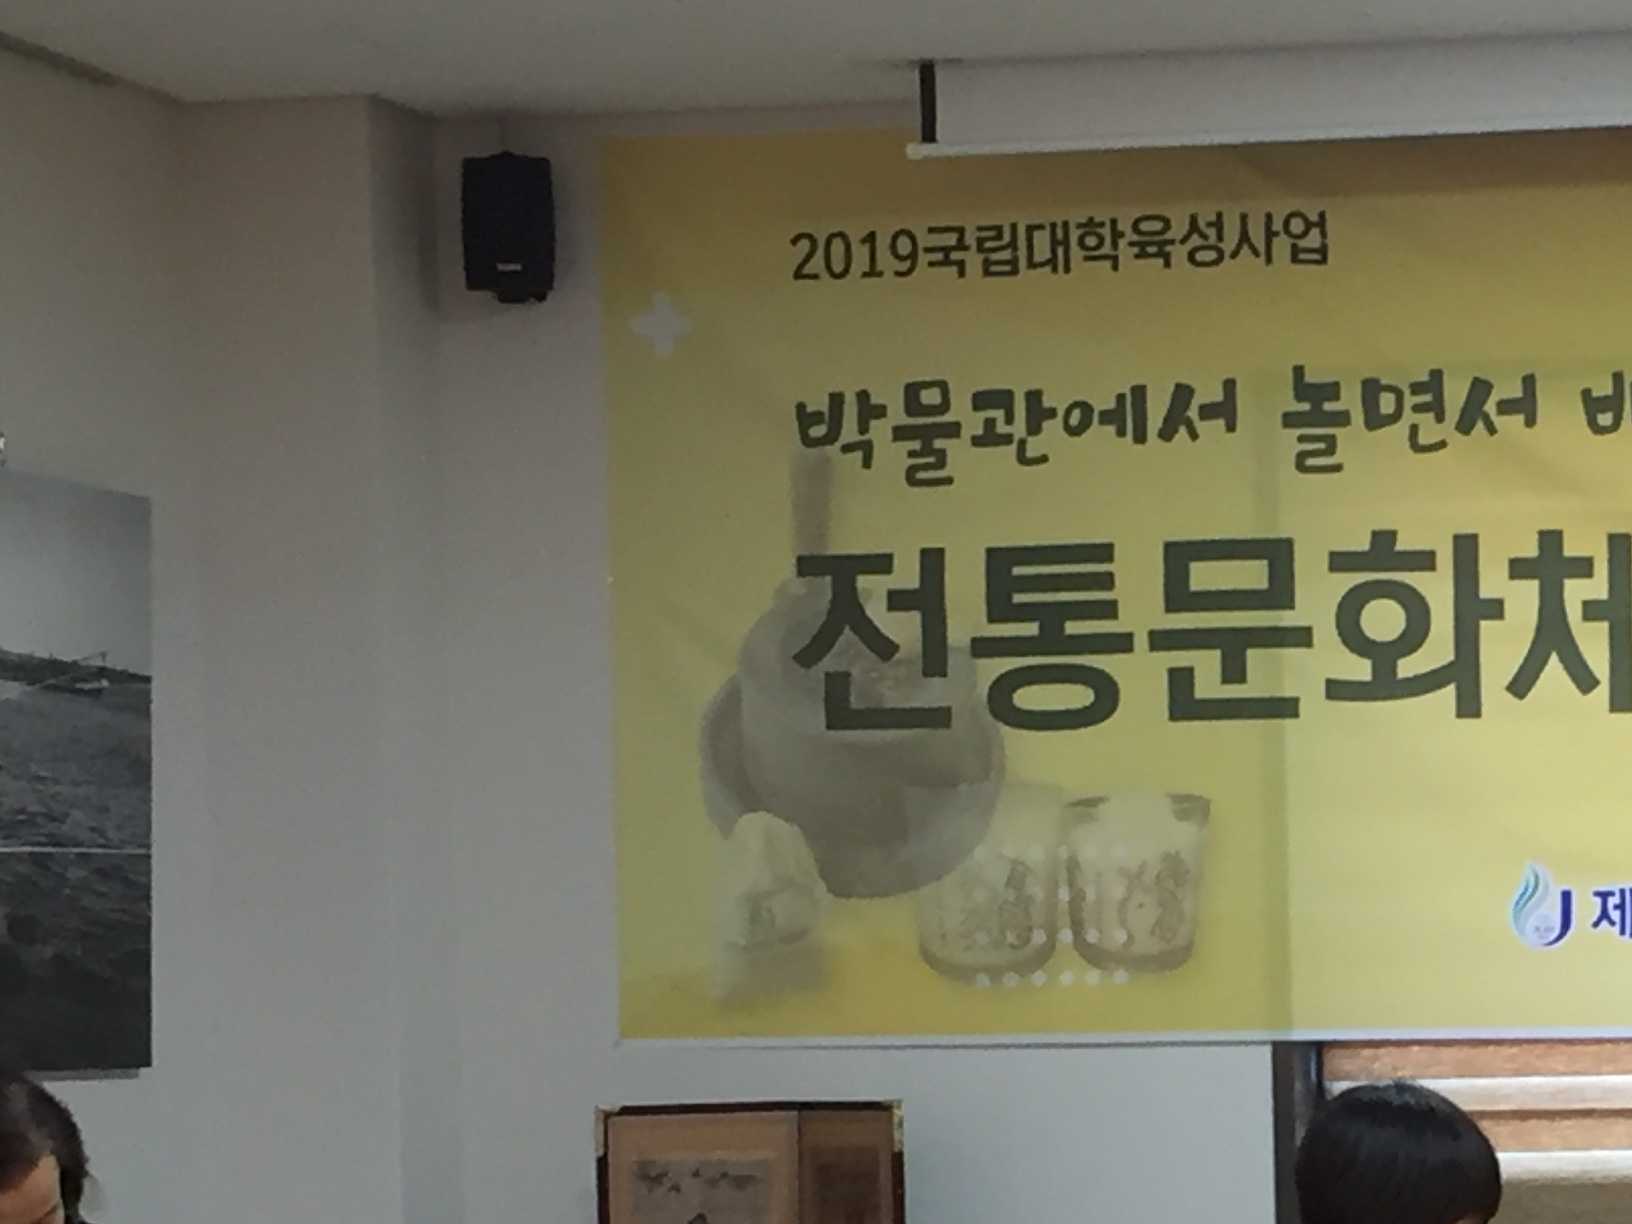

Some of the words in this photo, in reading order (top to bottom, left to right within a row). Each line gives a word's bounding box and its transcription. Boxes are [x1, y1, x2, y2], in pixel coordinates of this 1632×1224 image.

[790, 210, 1329, 281] 2019국립대학육성사업
[795, 378, 1237, 487] 박물관에서
[1281, 364, 1537, 474] 놀면서
